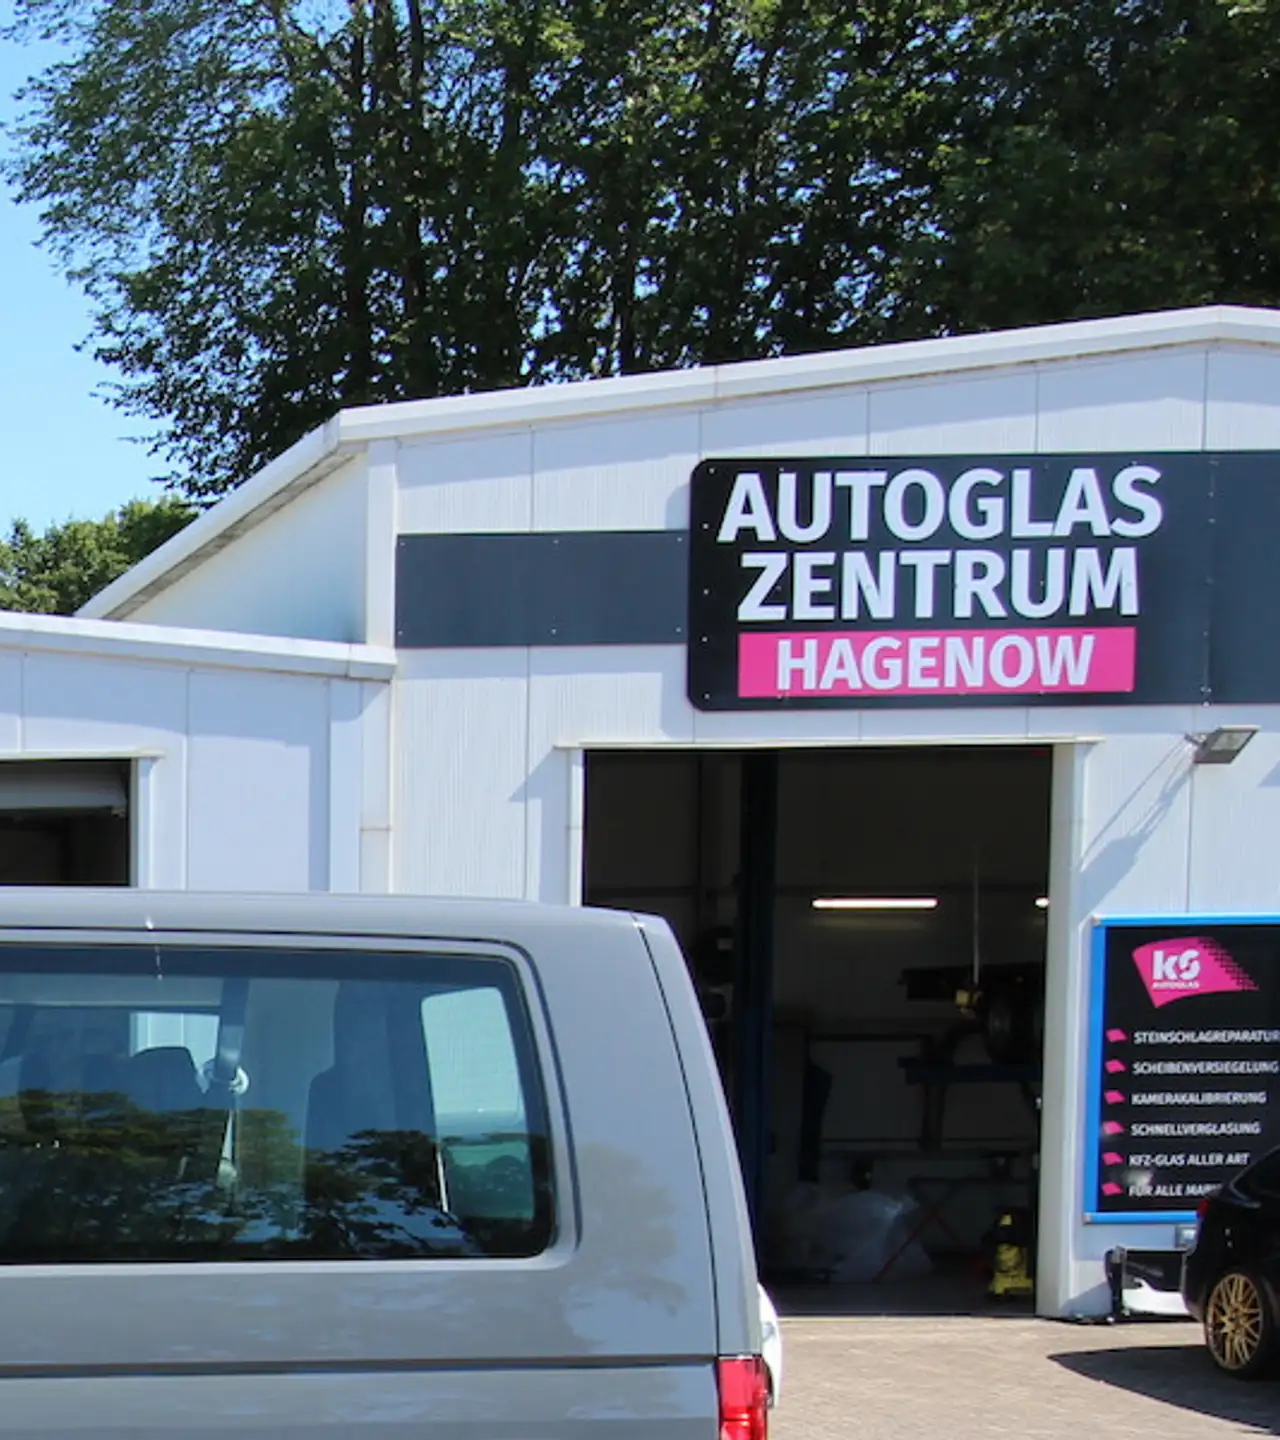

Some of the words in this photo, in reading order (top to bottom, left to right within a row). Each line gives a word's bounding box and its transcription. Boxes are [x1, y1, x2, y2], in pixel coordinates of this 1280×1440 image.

[718, 466, 1161, 542] AUTOGLAS
[738, 548, 1137, 620] ZENTRUM
[778, 635, 1094, 689] HAGENOW
[1131, 1122, 1261, 1136] SCHNELLVERGLASUNG
[1129, 1154, 1185, 1167] KFZ-GLAS
[1187, 1153, 1223, 1165] ALLER
[1225, 1152, 1250, 1165] ART
[1154, 1184, 1183, 1196] ALLE
